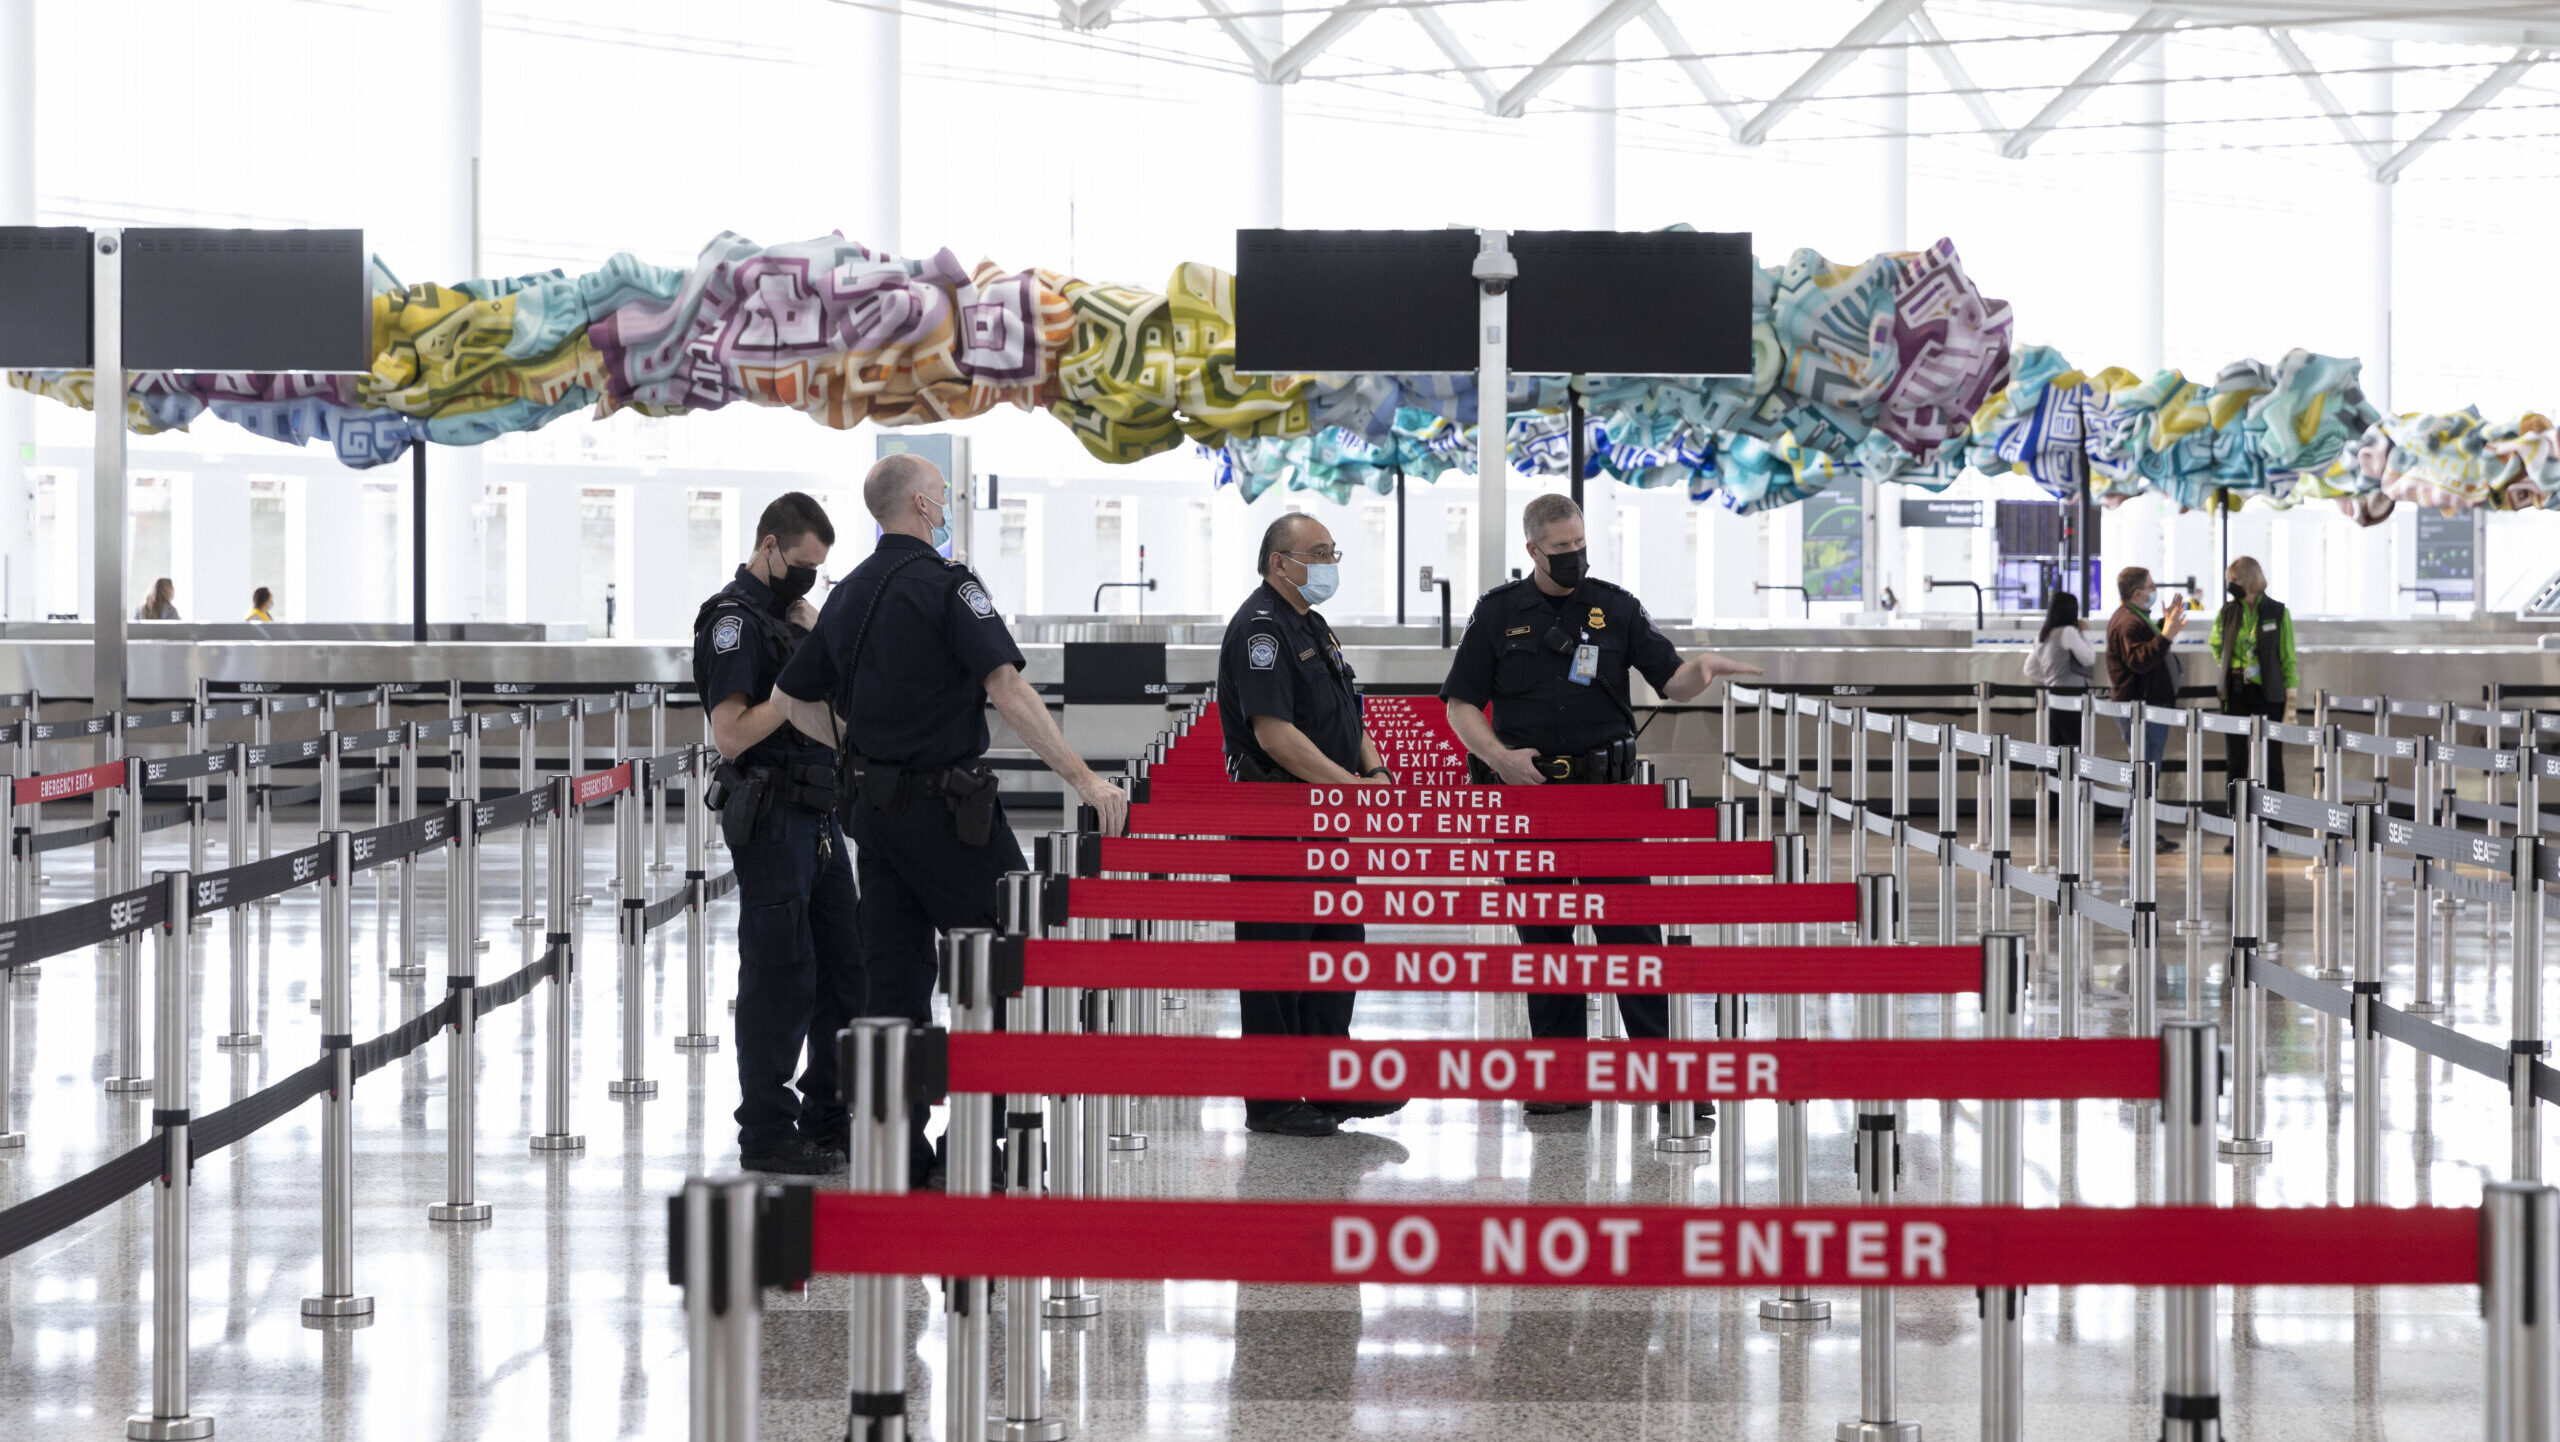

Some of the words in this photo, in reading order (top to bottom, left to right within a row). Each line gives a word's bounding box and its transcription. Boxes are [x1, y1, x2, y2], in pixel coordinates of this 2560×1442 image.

[240, 684, 263, 692] SEA
[494, 684, 518, 693] SEA
[1144, 684, 1168, 694] SEA
[1833, 686, 1857, 695] SEA
[1395, 739, 1432, 751] EXIT
[209, 756, 218, 770] SEA
[250, 750, 259, 763] SEA
[1399, 753, 1439, 768] EXIT
[2496, 754, 2508, 768] SEA
[2547, 759, 2560, 774] SEA
[149, 765, 159, 779] SEA
[1413, 771, 1457, 786] EXIT
[41, 776, 74, 798] EMERGENCY
[75, 772, 88, 791] EXIT
[532, 794, 543, 812] SEA
[1310, 788, 1344, 807] DO
[1357, 789, 1407, 807] NOT
[1420, 790, 1502, 808] ENTER
[2262, 795, 2275, 812] SEA
[477, 807, 489, 826] SEA
[1313, 812, 1351, 833] DO
[1366, 812, 1423, 833] NOT
[1437, 813, 1530, 834] ENTER
[2328, 808, 2341, 829] SEA
[425, 819, 437, 840] SEA
[2388, 822, 2403, 844] SEA
[354, 839, 369, 860] SEA
[1307, 847, 1350, 871] DO
[1367, 848, 1432, 871] NOT
[1449, 849, 1556, 872] ENTER
[2472, 838, 2490, 861] SEA
[293, 855, 309, 881] SEA
[198, 882, 216, 907] SEA
[1313, 889, 1364, 917] DO
[1384, 890, 1461, 918] NOT
[1480, 891, 1605, 920] ENTER
[110, 903, 132, 930] SEA
[1309, 950, 1370, 984] DO
[1395, 951, 1488, 984] NOT
[1511, 953, 1663, 987] ENTER
[1329, 1048, 1407, 1091] DO
[1438, 1048, 1556, 1091] NOT
[1586, 1051, 1779, 1094] ENTER
[1331, 1216, 1439, 1275] DO
[1481, 1217, 1642, 1276] NOT
[1683, 1220, 1946, 1278] ENTER
